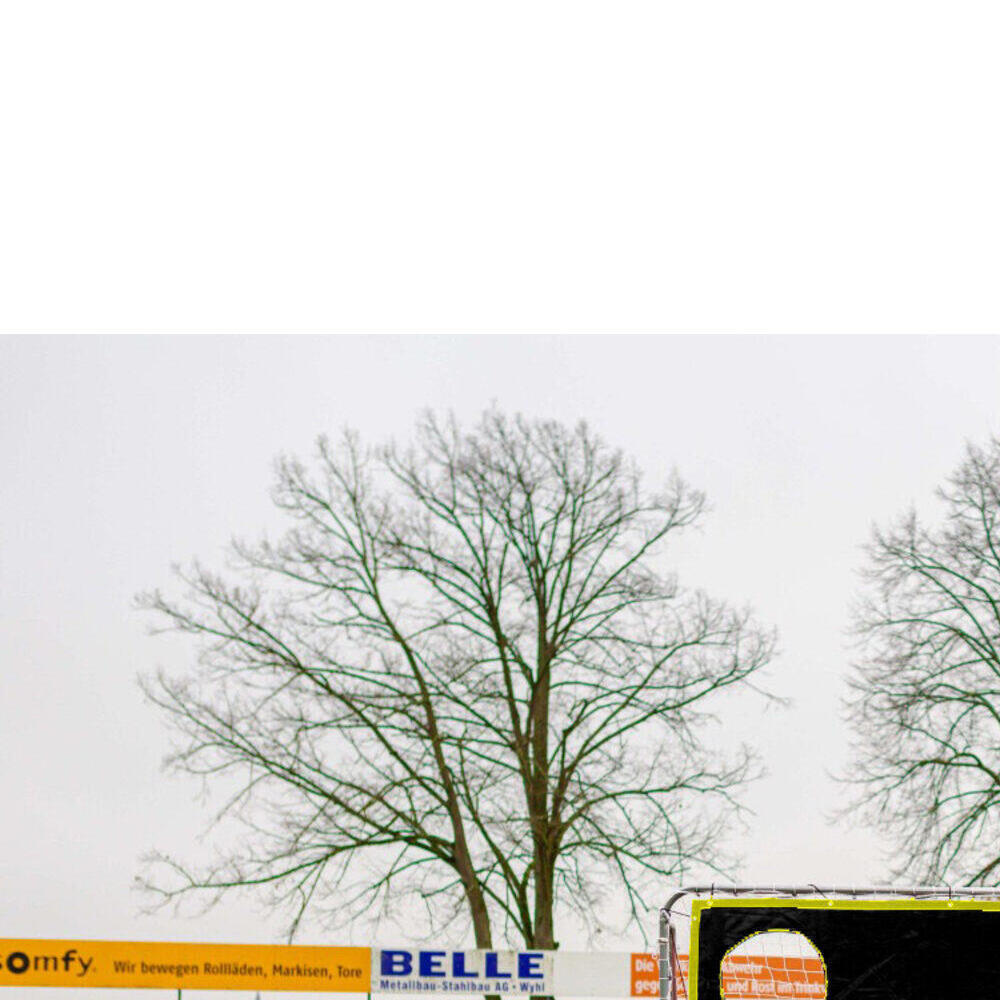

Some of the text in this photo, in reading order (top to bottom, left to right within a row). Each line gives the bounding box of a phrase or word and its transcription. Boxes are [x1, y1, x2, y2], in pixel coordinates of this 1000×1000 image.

[0, 949, 94, 978] omfy
[113, 960, 137, 975] Wir
[140, 961, 199, 978] bewegen
[272, 965, 333, 981] Markisen,
[337, 965, 363, 979] Tore
[379, 950, 544, 979] BELLE
[379, 979, 545, 993] Metallbau-Stahlbau AG Wyhl
